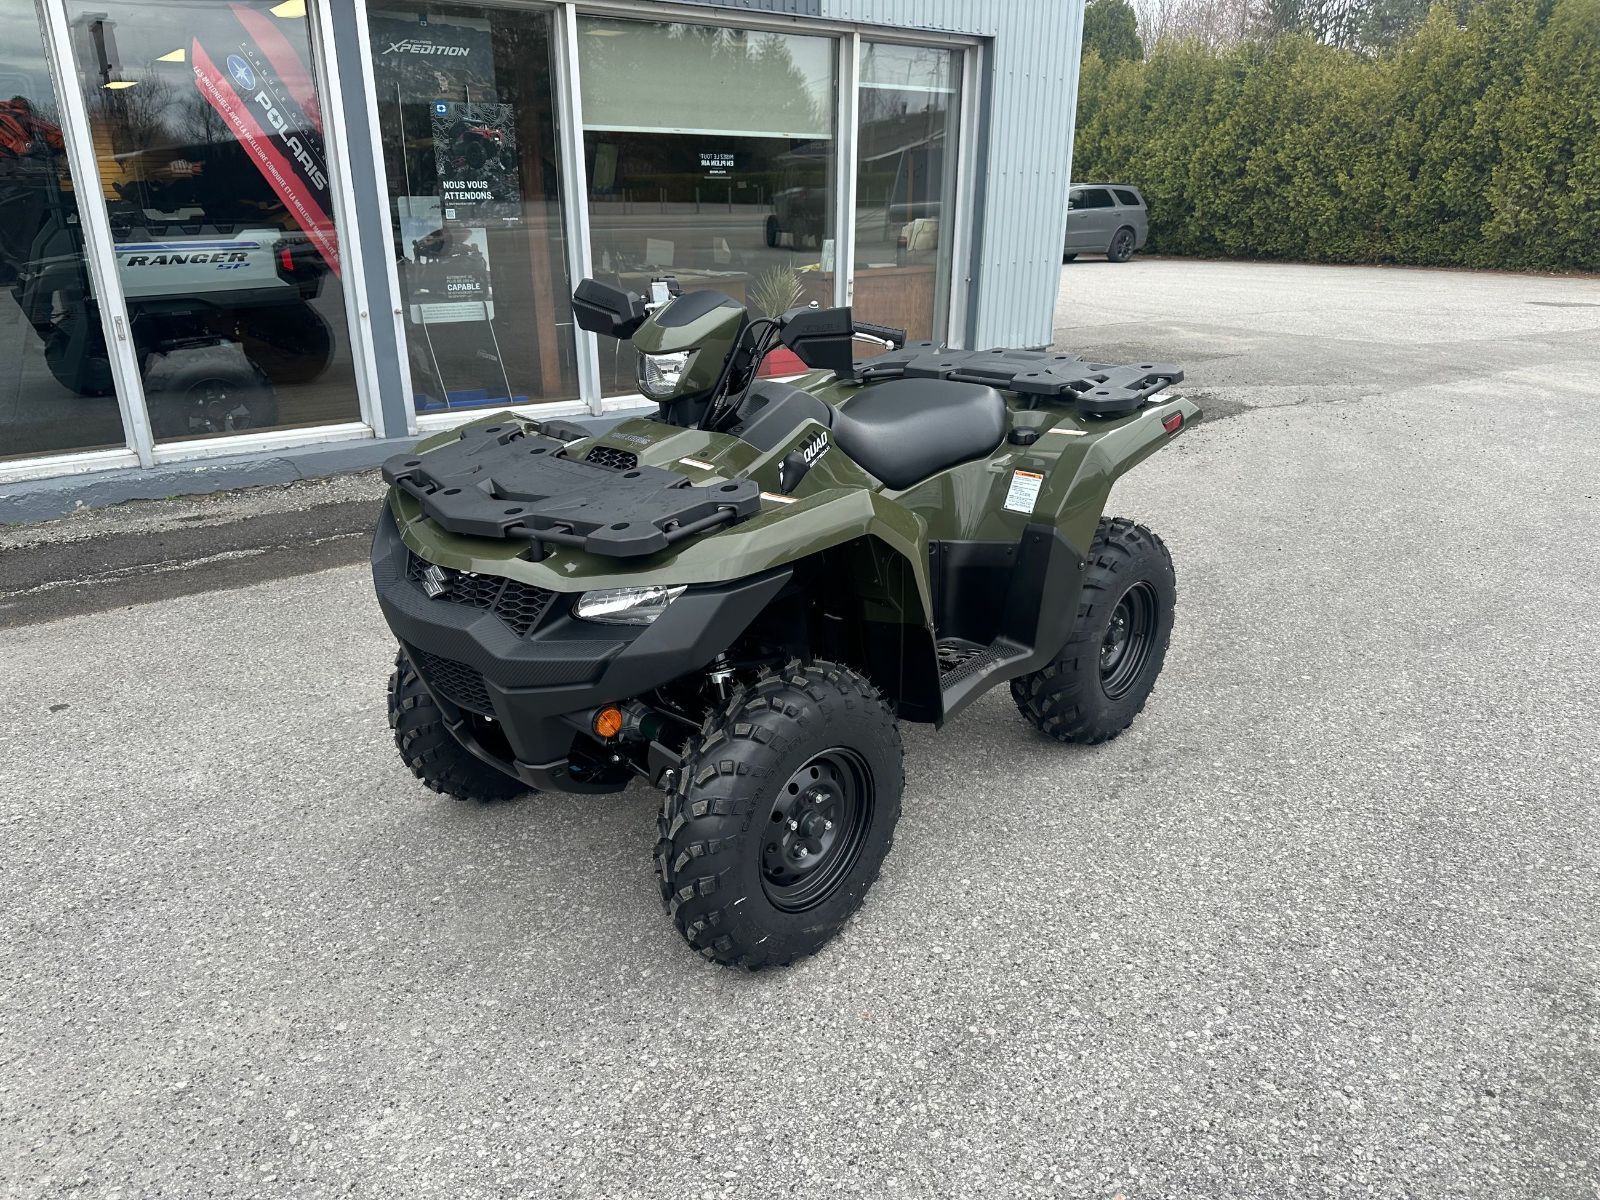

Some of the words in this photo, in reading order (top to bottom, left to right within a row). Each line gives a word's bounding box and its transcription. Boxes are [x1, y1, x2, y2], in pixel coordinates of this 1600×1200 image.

[382, 39, 470, 57] XPEDITION
[193, 66, 205, 79] LES
[201, 73, 231, 114] MOTONEIGES
[228, 110, 242, 128] AVEC
[244, 130, 269, 163] MEILLEURE
[265, 160, 286, 190] CONDUITE
[294, 199, 316, 227] MEILLEURE
[254, 90, 328, 191] POLARIS
[442, 180, 466, 189] NOUS
[466, 180, 489, 189] VOUS
[444, 191, 495, 200] ATTENDONS.
[126, 252, 249, 267] RANGER
[447, 282, 481, 291] CAPABLE
